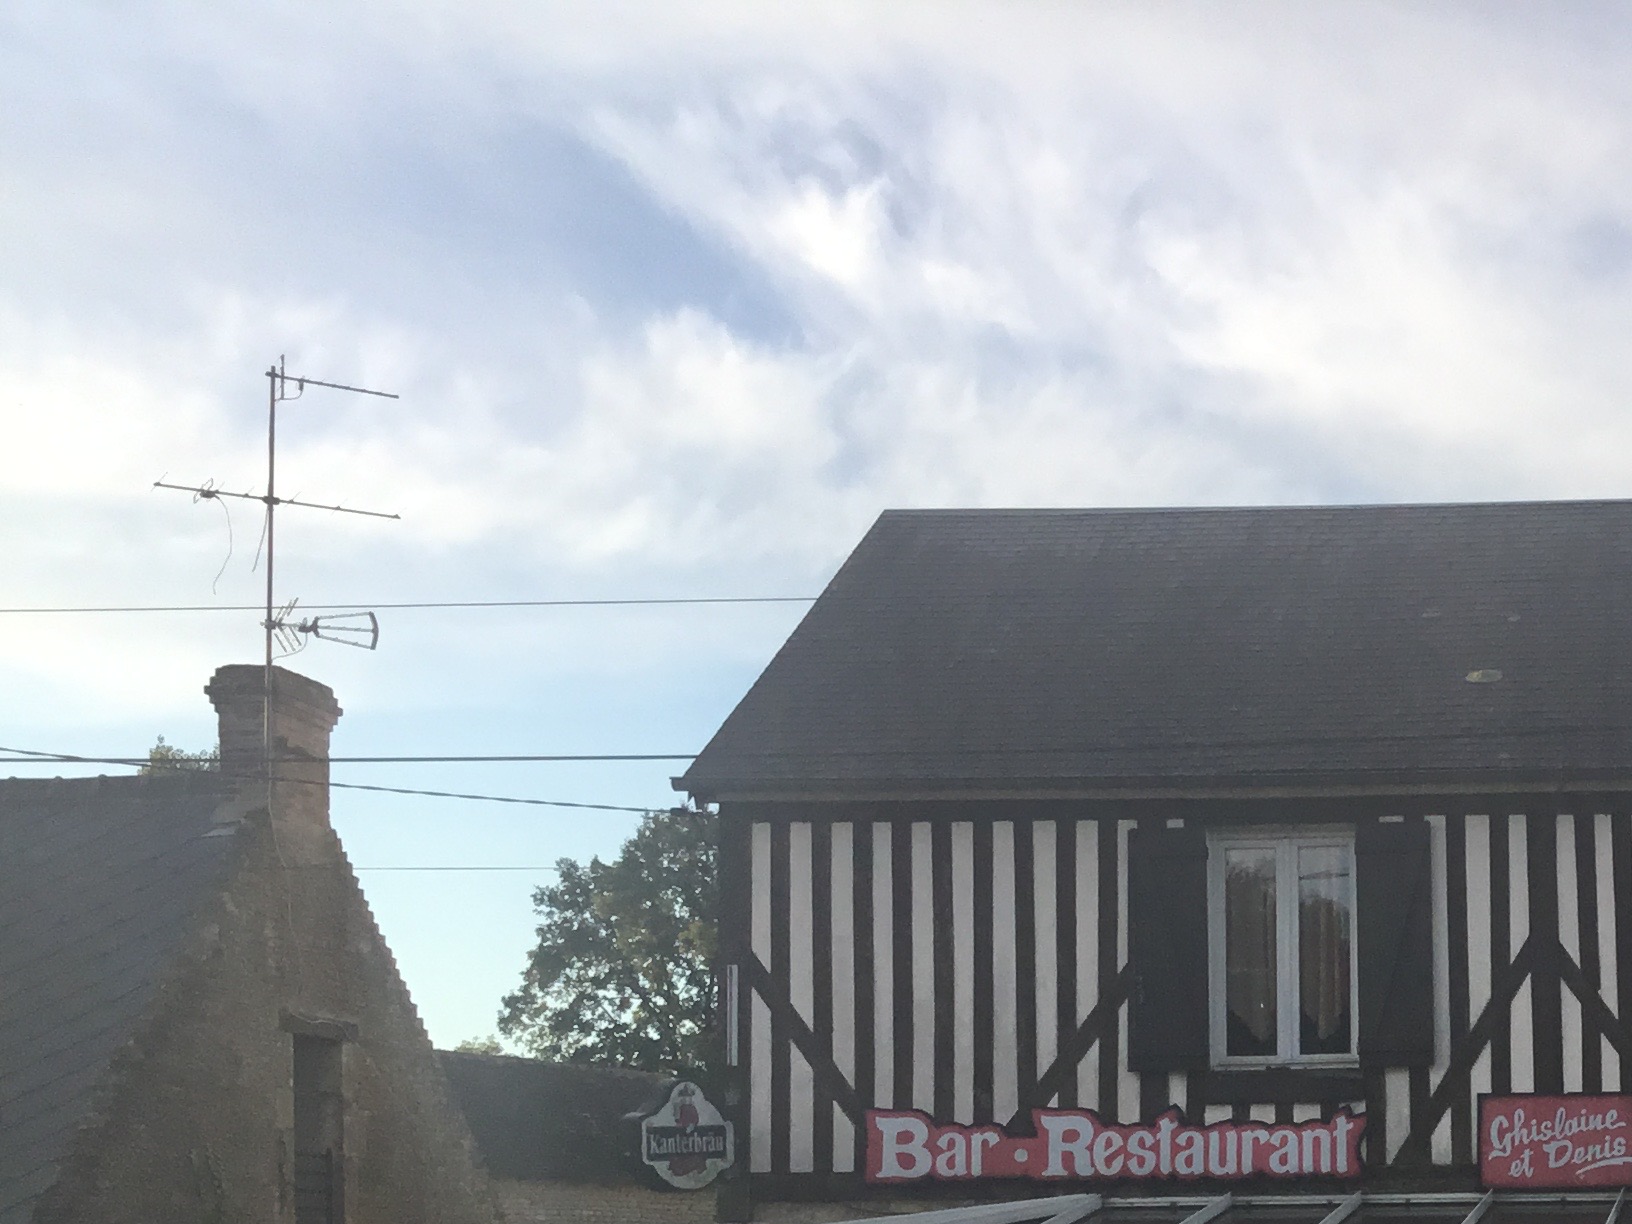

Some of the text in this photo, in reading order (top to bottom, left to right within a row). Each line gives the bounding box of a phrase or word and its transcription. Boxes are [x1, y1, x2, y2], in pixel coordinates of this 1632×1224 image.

[875, 1114, 1354, 1179] Bar Restaurant
[1488, 1107, 1626, 1160] Ghislaine
[1508, 1135, 1627, 1178] et Denis
